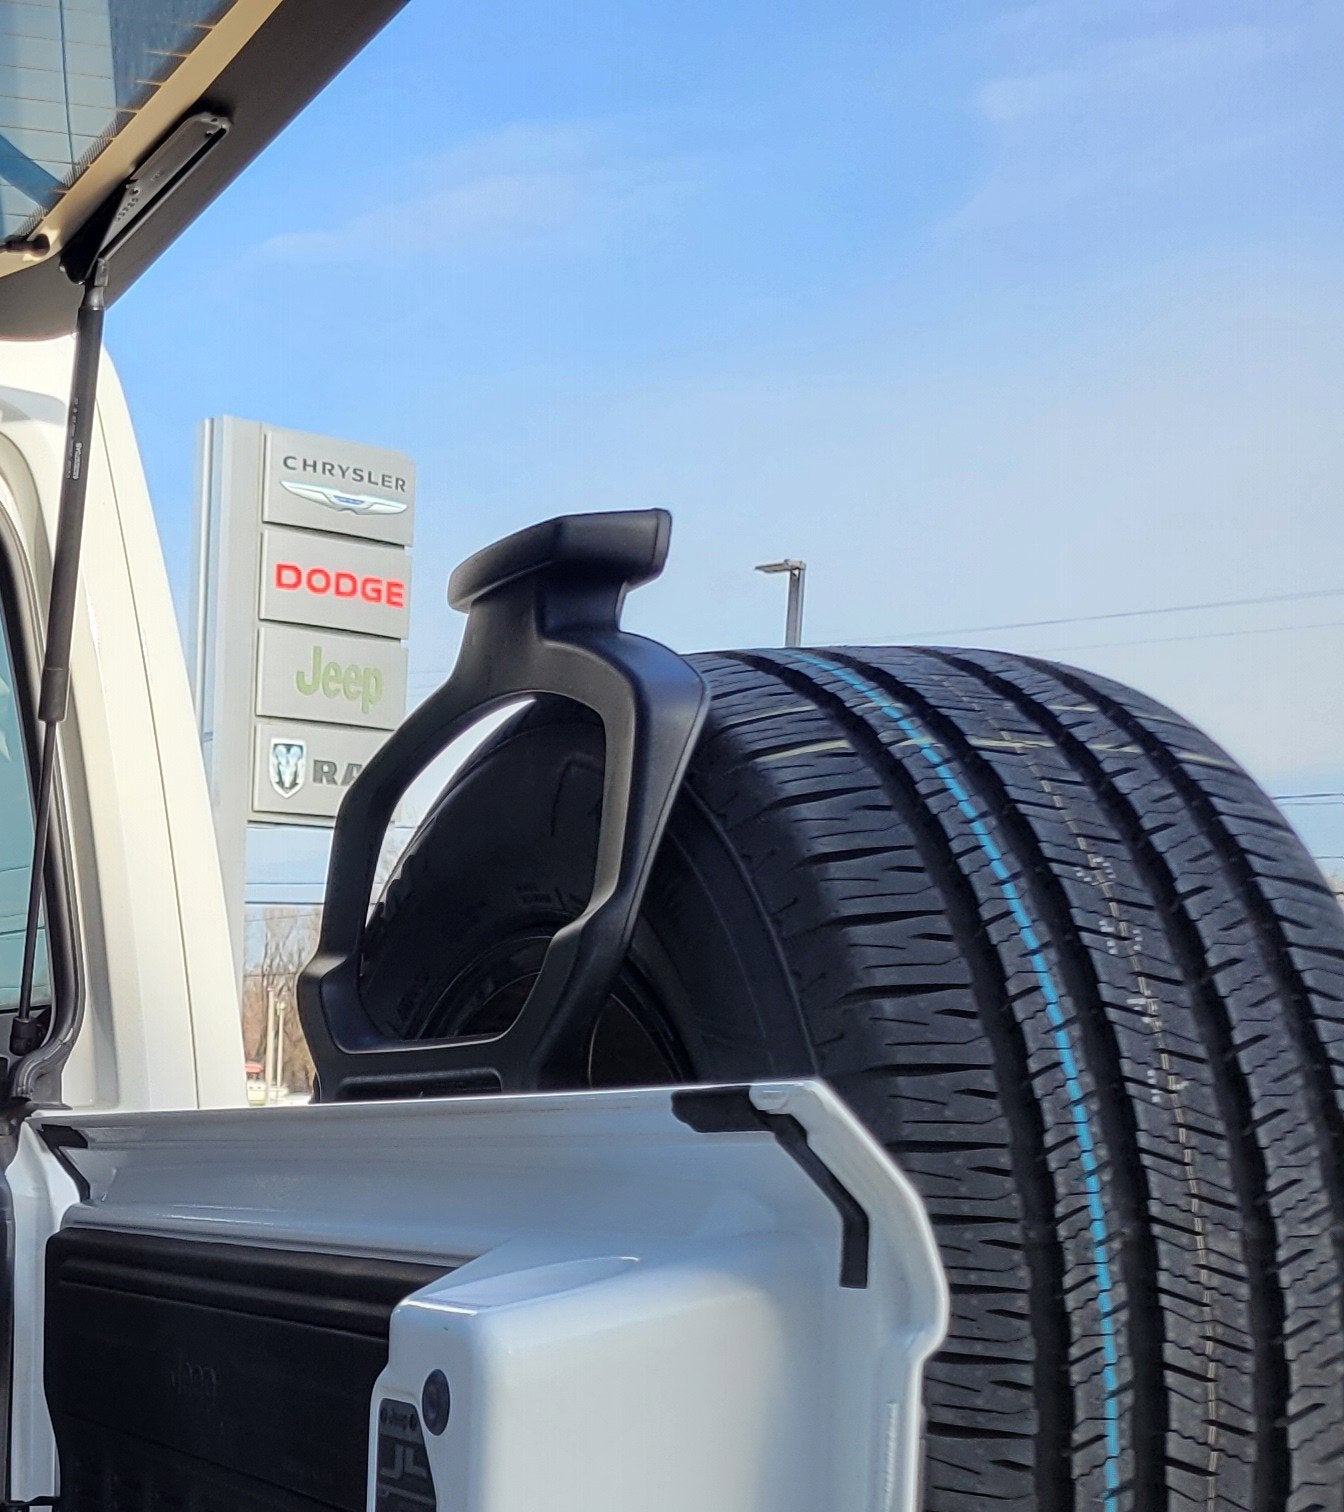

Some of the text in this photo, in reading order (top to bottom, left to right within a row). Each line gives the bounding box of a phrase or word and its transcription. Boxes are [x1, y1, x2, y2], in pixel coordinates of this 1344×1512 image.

[282, 455, 407, 493] CHRYSLER
[275, 563, 404, 608] DODGE
[295, 645, 383, 715] Jeep
[312, 759, 363, 786] RA
